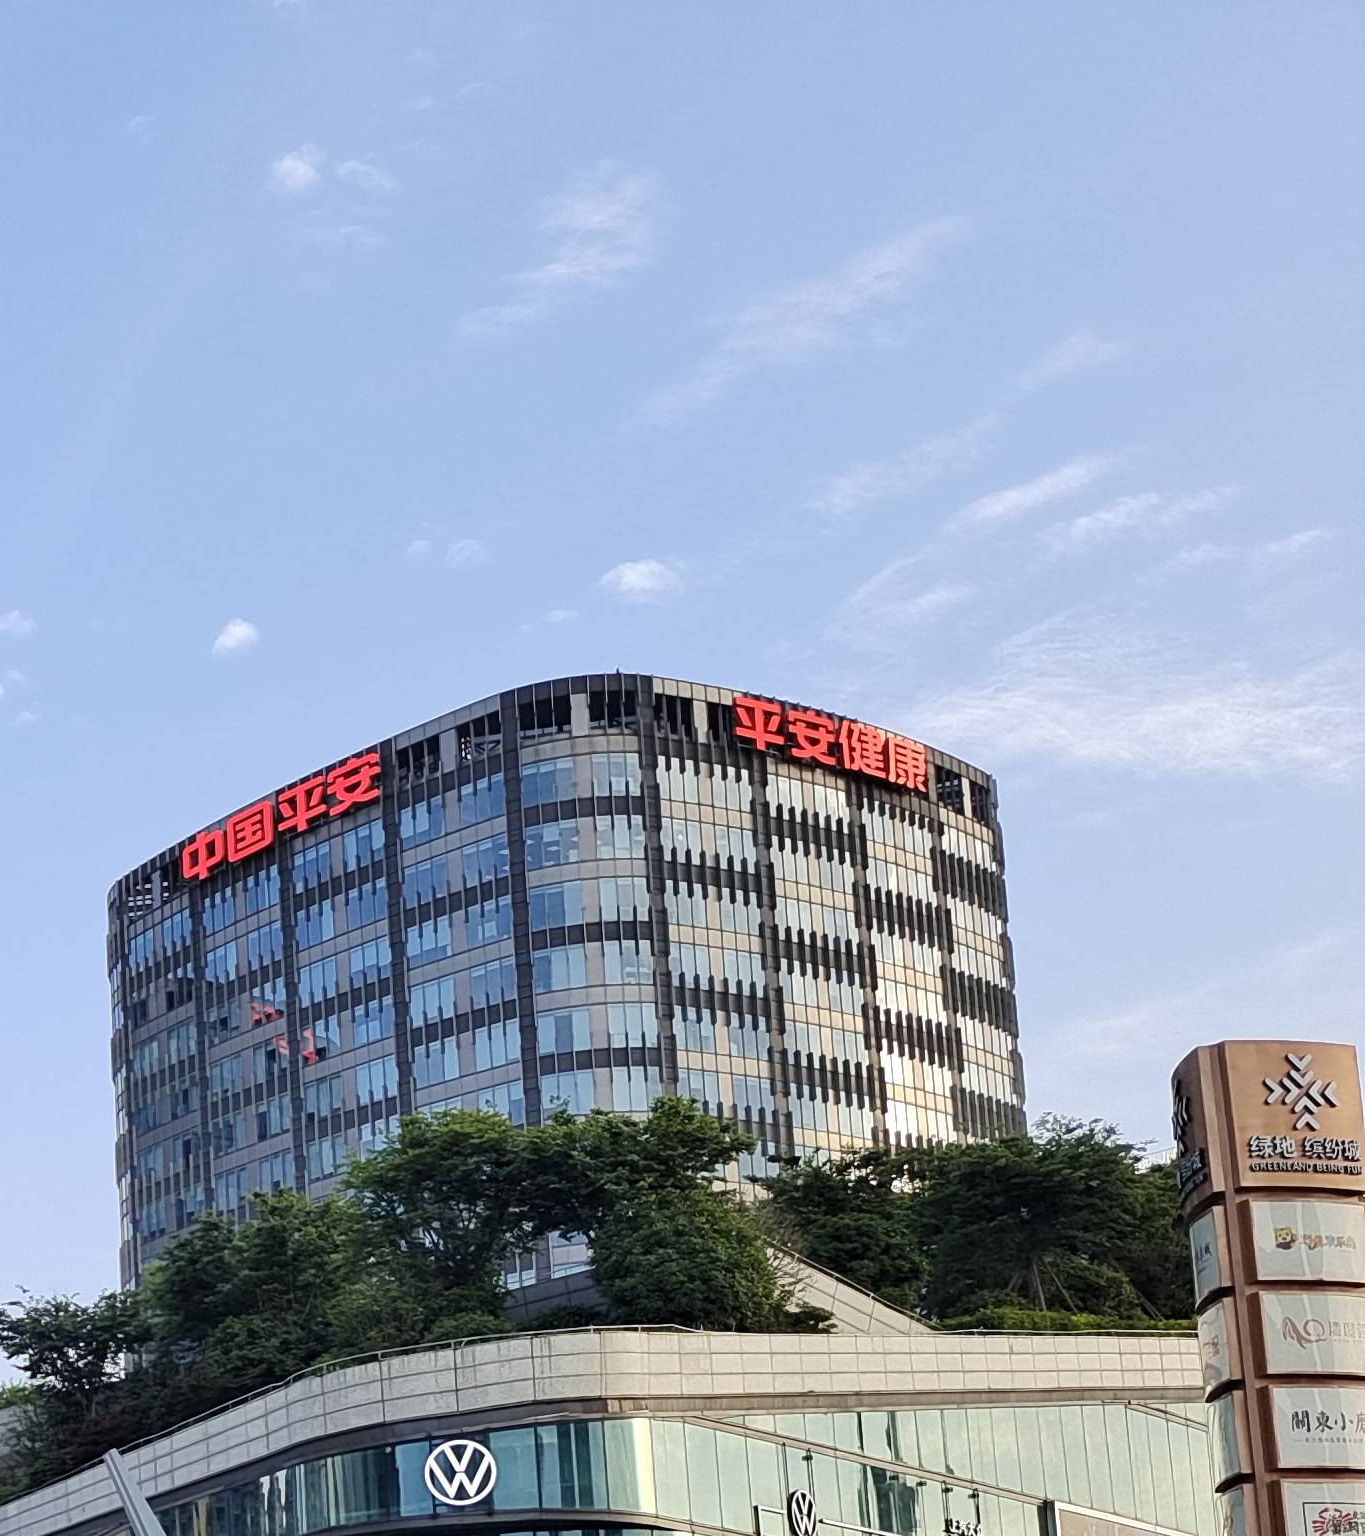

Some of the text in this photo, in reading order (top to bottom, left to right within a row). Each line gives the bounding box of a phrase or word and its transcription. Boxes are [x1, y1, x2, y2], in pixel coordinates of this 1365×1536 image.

[734, 695, 929, 793] 平安健康
[181, 753, 382, 881] 中国平安
[1250, 1135, 1361, 1161] 绿地 缤纷城
